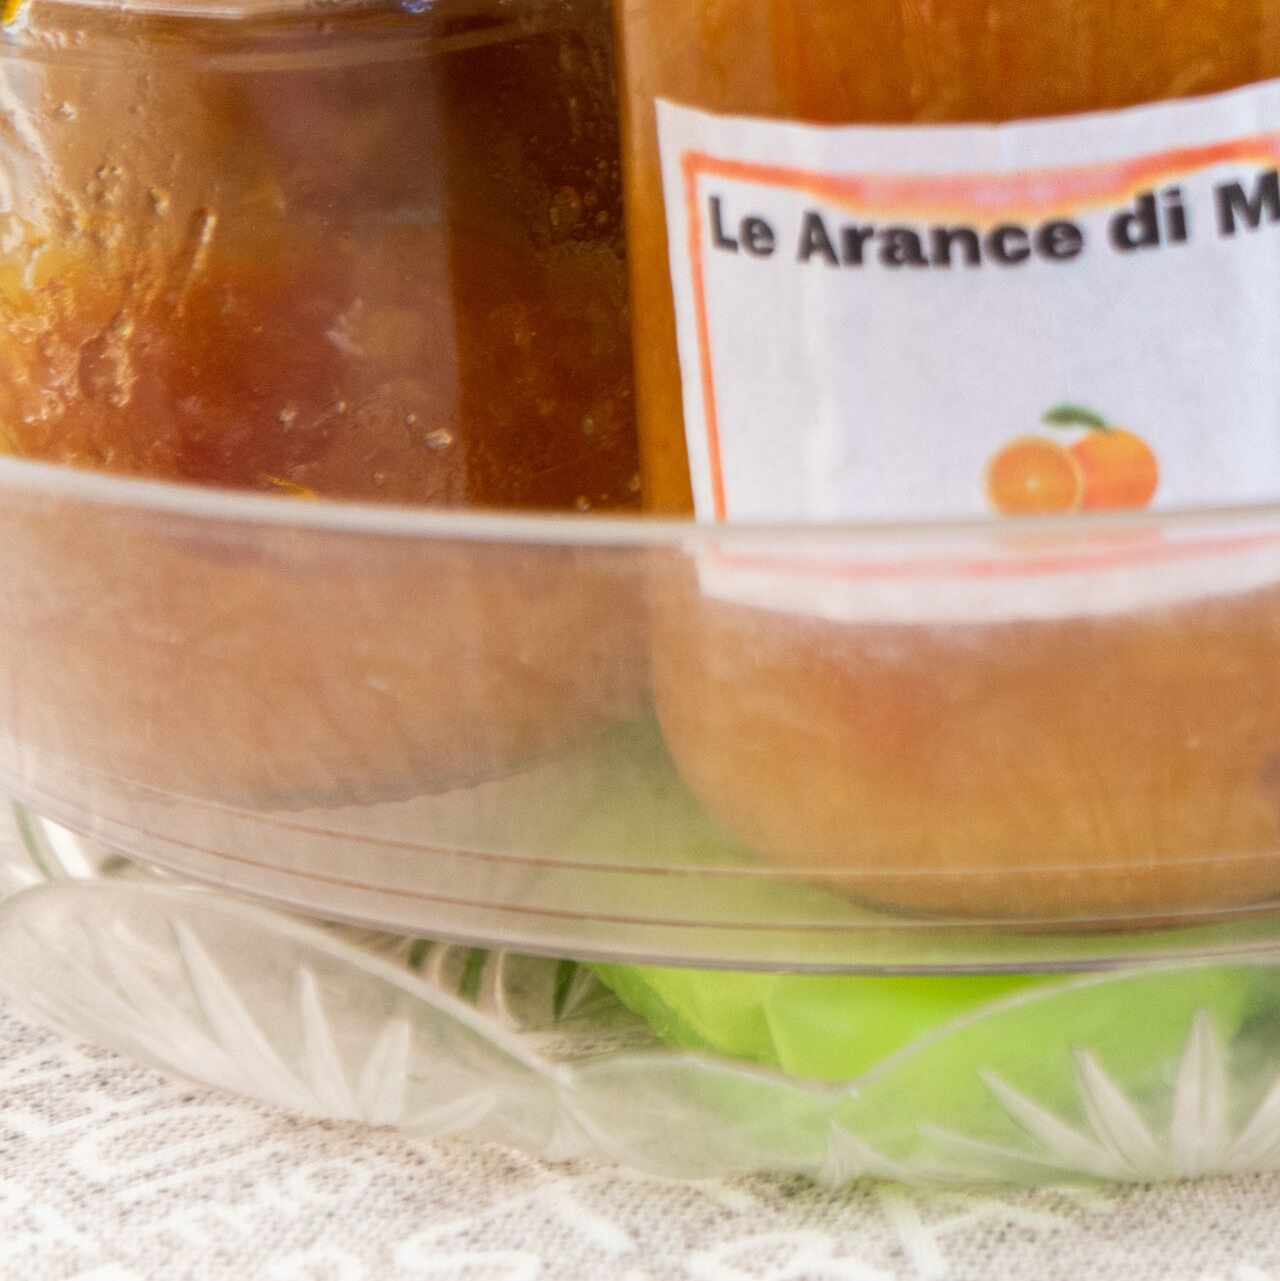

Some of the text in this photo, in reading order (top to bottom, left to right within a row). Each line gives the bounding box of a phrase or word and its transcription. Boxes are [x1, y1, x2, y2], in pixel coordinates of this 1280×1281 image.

[710, 196, 775, 256] Le
[801, 211, 1084, 268] Arance
[1111, 188, 1188, 252] di
